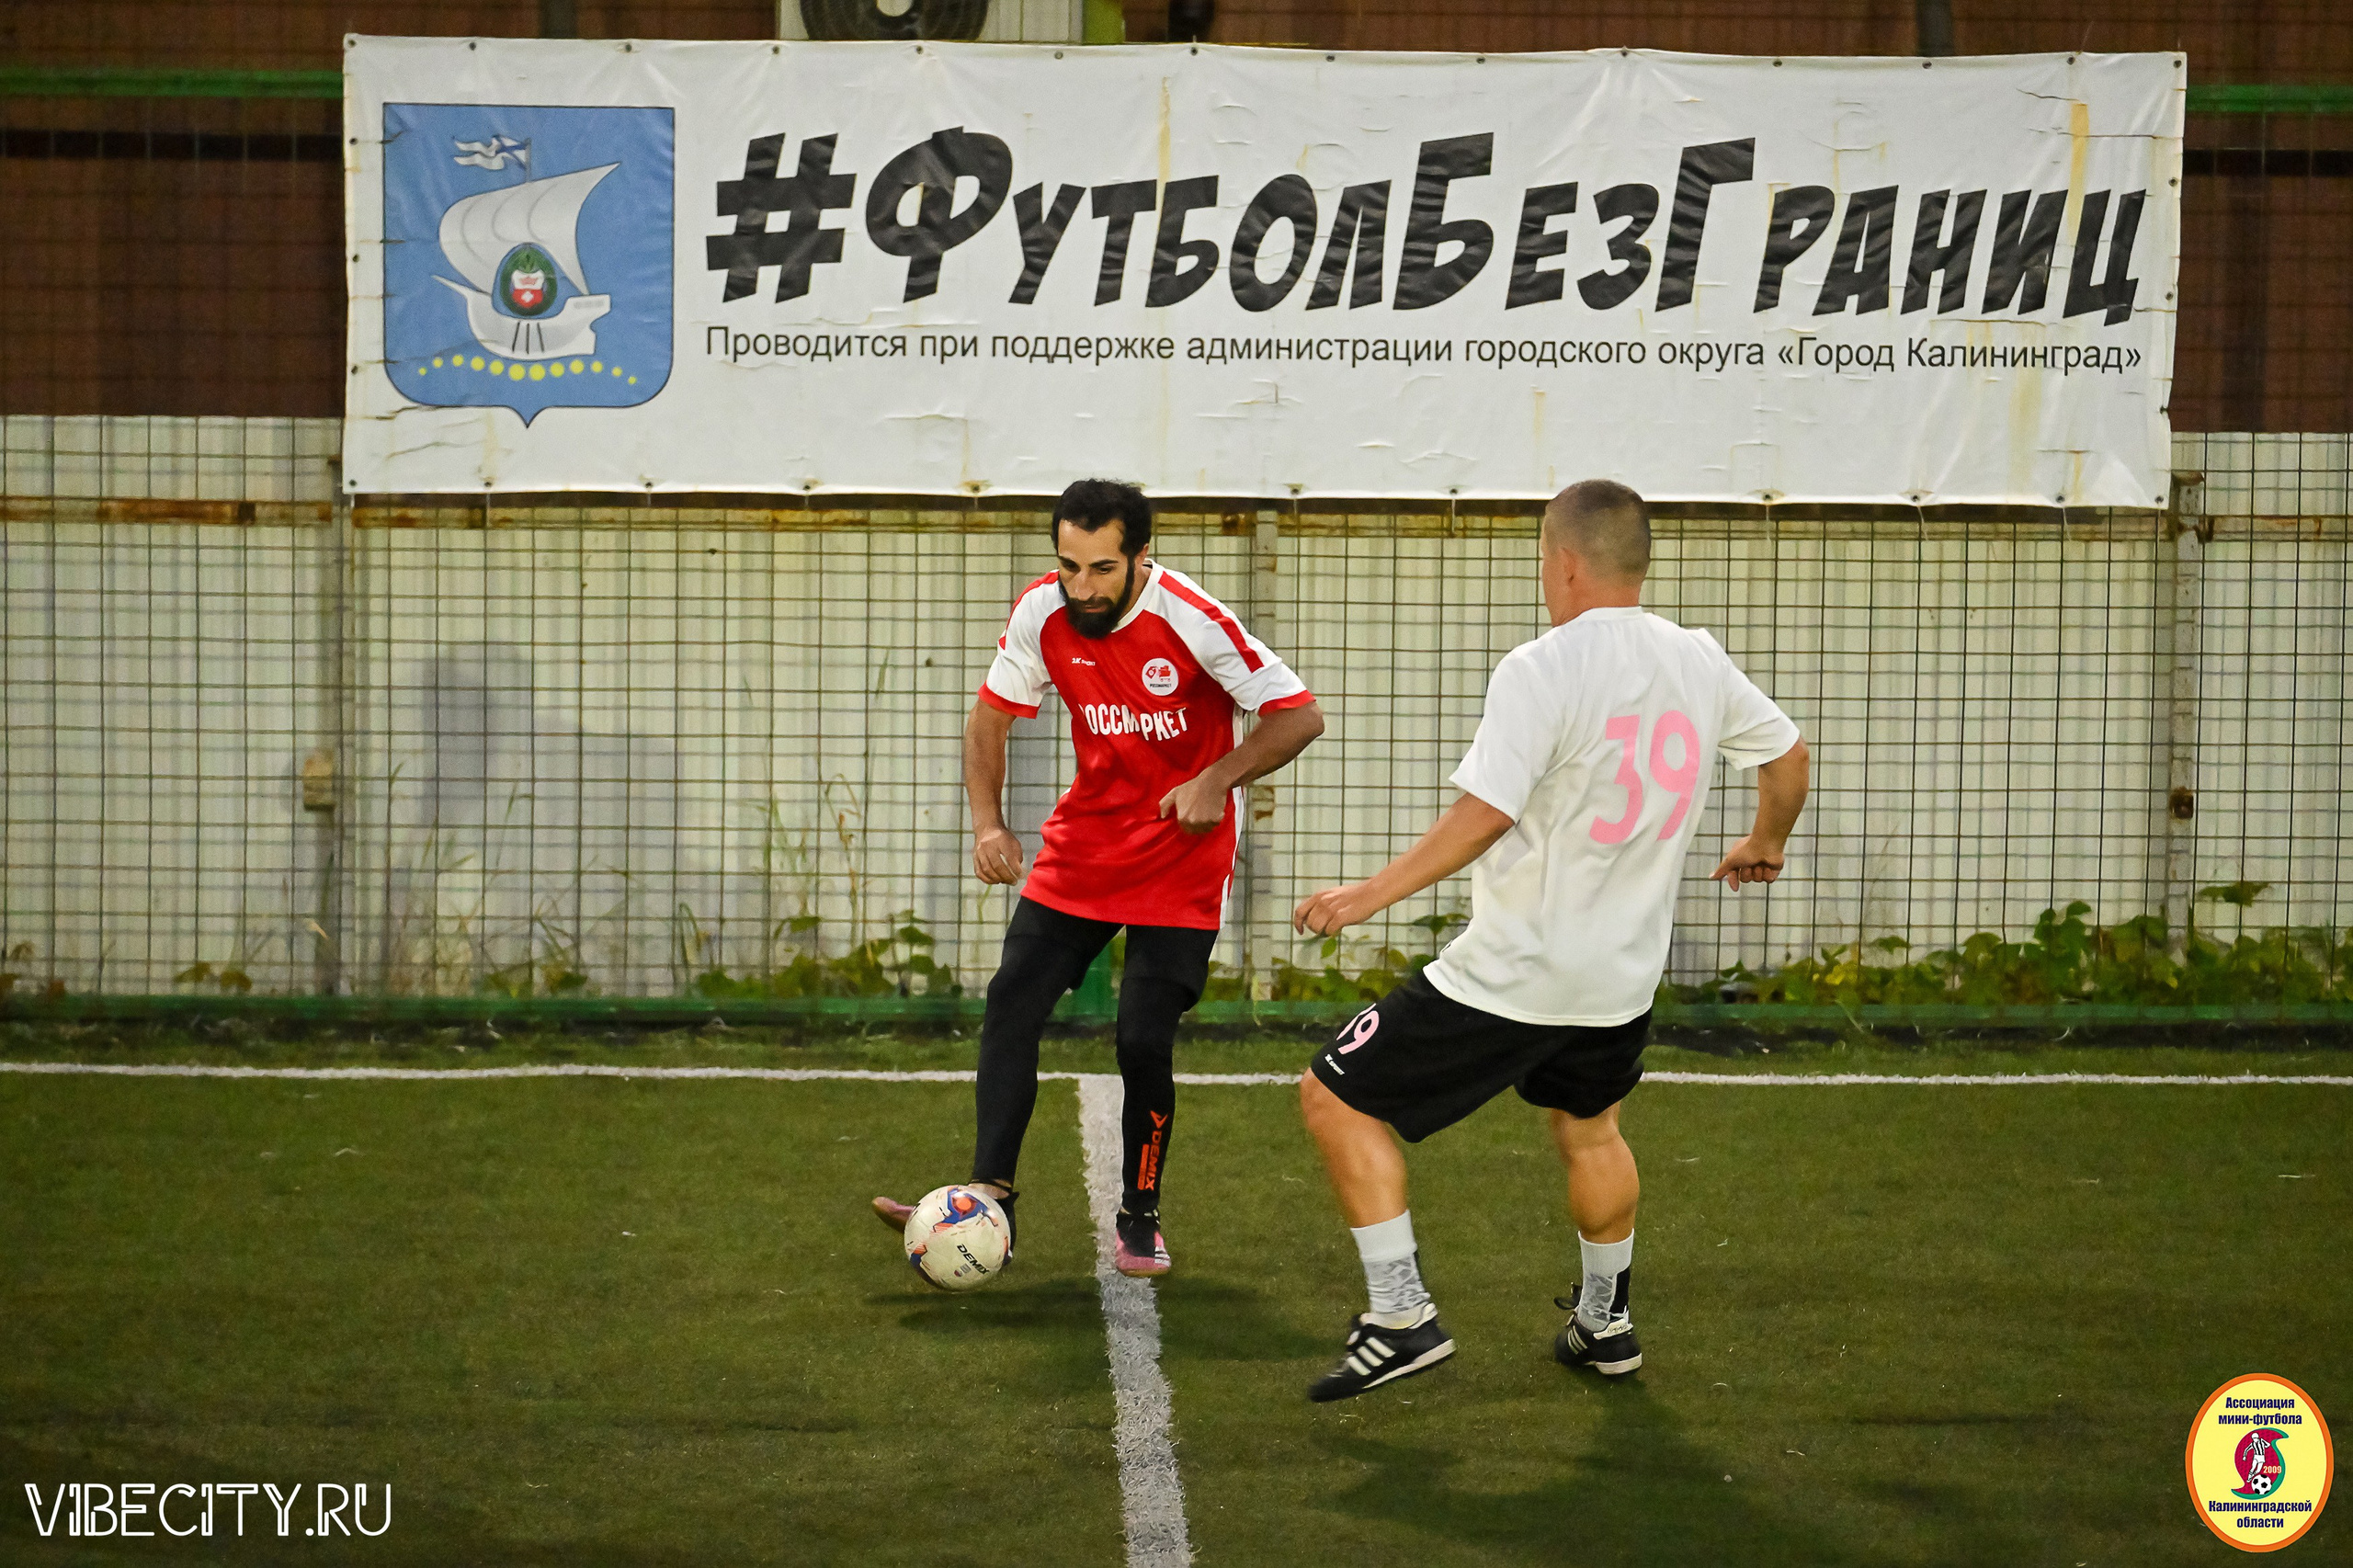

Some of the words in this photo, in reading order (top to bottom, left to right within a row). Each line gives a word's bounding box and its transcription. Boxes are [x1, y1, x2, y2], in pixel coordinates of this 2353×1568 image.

[706, 325, 906, 363] Проводится
[915, 335, 978, 365] при
[991, 335, 1175, 367] поддержке
[1187, 336, 1452, 368] администрации
[1465, 338, 1647, 369] городского
[1657, 343, 1765, 372] округа
[1778, 337, 1895, 374] «Город
[1907, 338, 2142, 376] Калининград»
[1078, 703, 1188, 741] ОССМРКЕТ
[1589, 710, 1700, 845] 39
[1145, 1130, 1163, 1191] DEMIX
[957, 1244, 990, 1275] DEMIX
